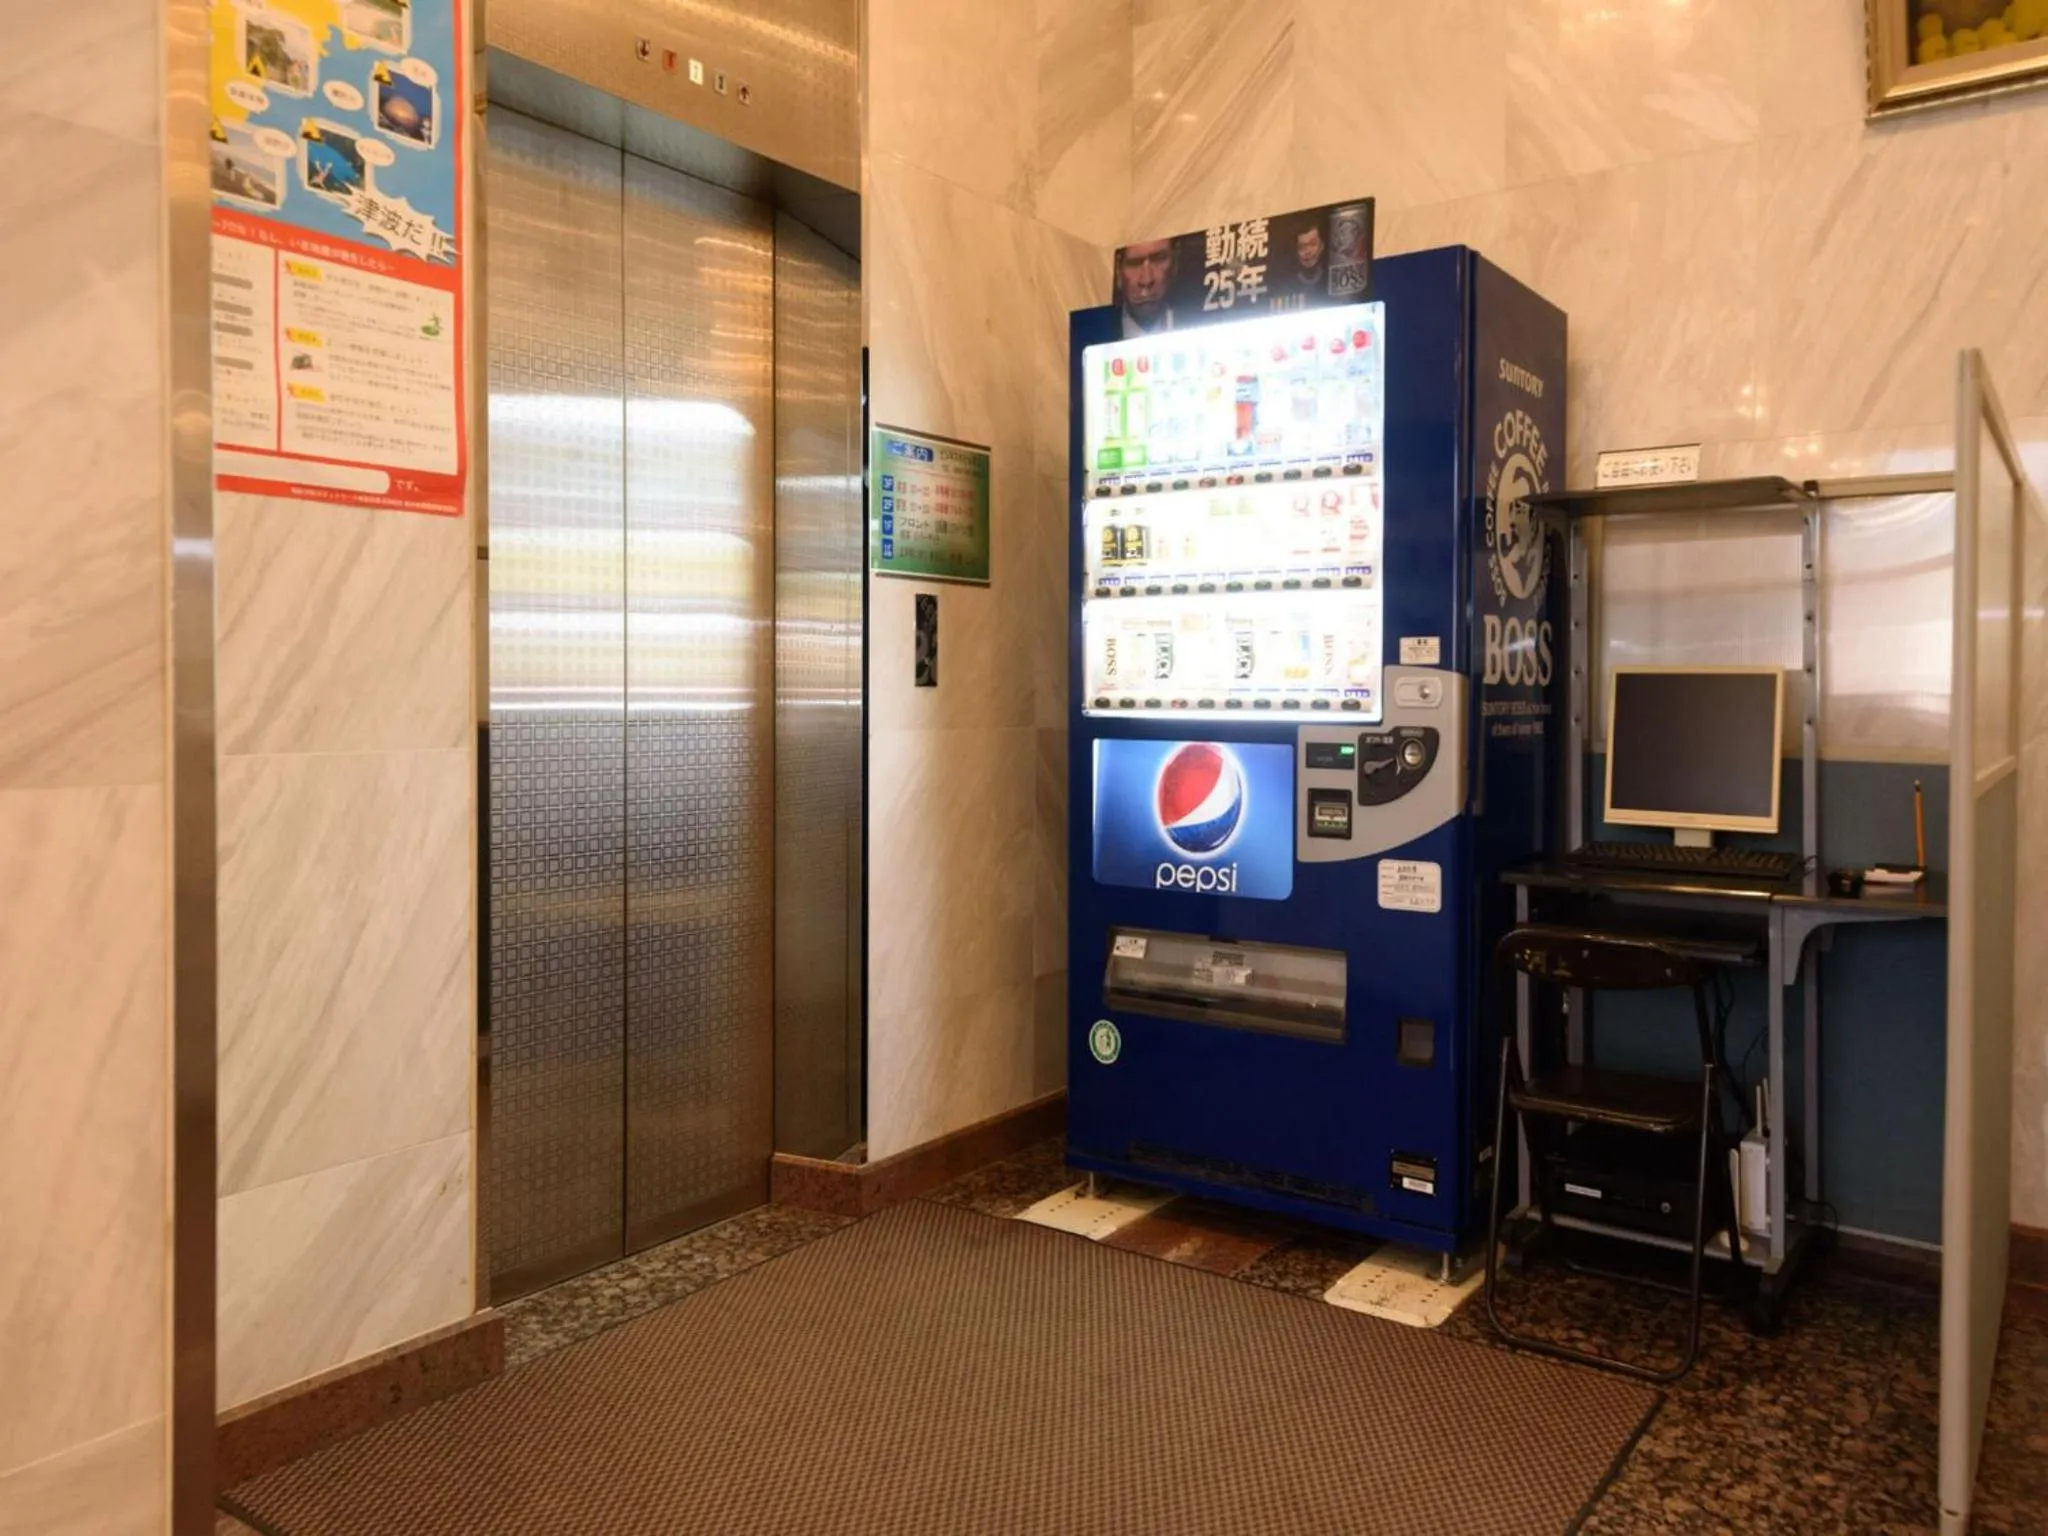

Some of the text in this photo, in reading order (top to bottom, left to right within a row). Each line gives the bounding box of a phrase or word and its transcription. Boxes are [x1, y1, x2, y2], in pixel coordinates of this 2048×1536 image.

[1204, 218, 1269, 268] 勤続
[1203, 264, 1268, 312] 25年
[1499, 357, 1545, 399] SUNTORY
[891, 442, 929, 461] ご案内
[1494, 408, 1549, 477] COFFEE
[1106, 638, 1118, 676] BOSS
[1482, 613, 1553, 688] BOSS
[1155, 862, 1238, 893] pepsi
